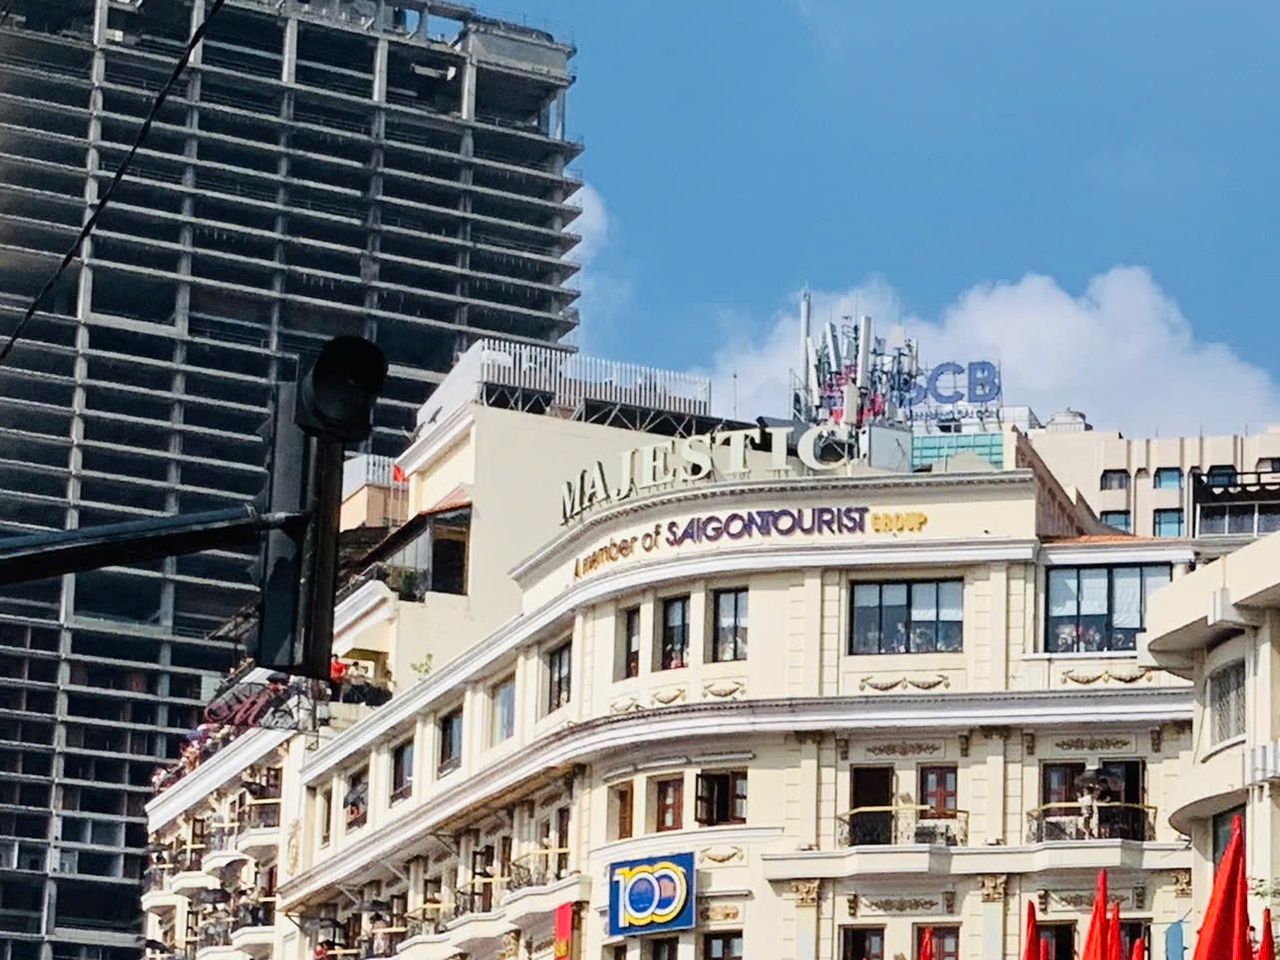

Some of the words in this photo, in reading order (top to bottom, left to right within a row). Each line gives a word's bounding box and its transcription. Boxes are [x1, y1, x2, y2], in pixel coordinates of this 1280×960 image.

[561, 423, 850, 525] MAJESTIC
[583, 536, 638, 575] member
[641, 523, 661, 552] of
[666, 507, 869, 546] SAIGONTOURIST
[613, 861, 687, 929] 100
